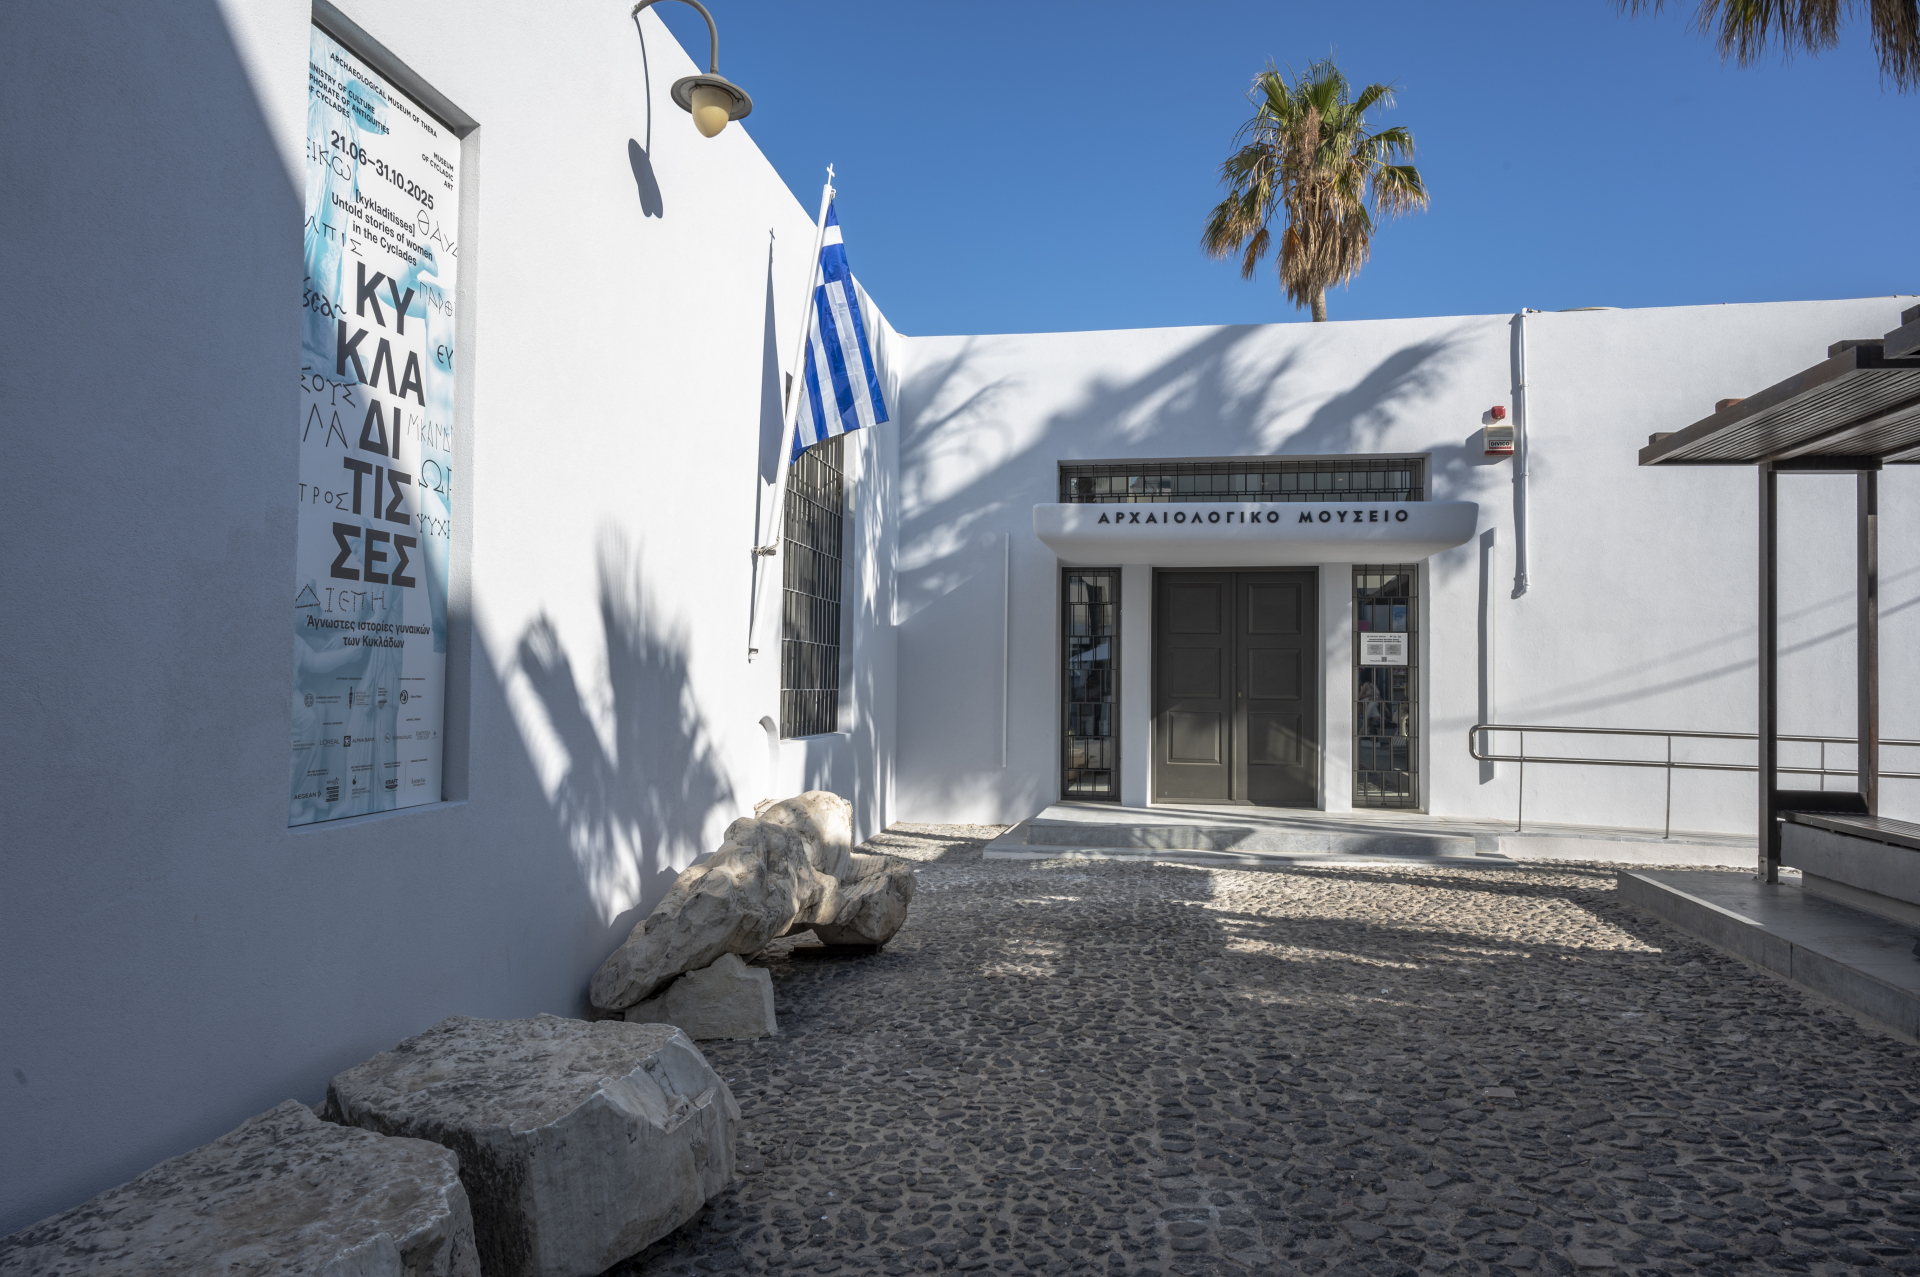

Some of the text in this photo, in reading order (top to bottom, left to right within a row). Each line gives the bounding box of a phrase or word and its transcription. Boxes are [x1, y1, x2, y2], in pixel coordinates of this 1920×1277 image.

[315, 89, 350, 119] CYCLADES
[330, 52, 437, 138] ARCHAEOLOGICAL MUSEUM OF THERA
[338, 82, 347, 93] OF
[348, 89, 375, 115] CULTURE
[341, 96, 350, 107] OF
[352, 101, 390, 135] ANTIQUITIES
[421, 153, 454, 182] OF CYCLADIC
[433, 152, 454, 172] MUSEUM
[443, 180, 454, 191] ART
[331, 192, 433, 262] Untold stories of women
[352, 220, 417, 267] in the Cyclades
[343, 456, 412, 526] ΤΙΣ
[1097, 508, 1410, 525] ΑΡΧΑΙΟΛΟΓΙΚΟ ΜΟΥΣΕΙΟ
[330, 521, 417, 588] ΣΕΣ
[306, 614, 431, 635] Άγνωστες ιστορίες γυναικών
[343, 635, 405, 649] των Κυκλάδων
